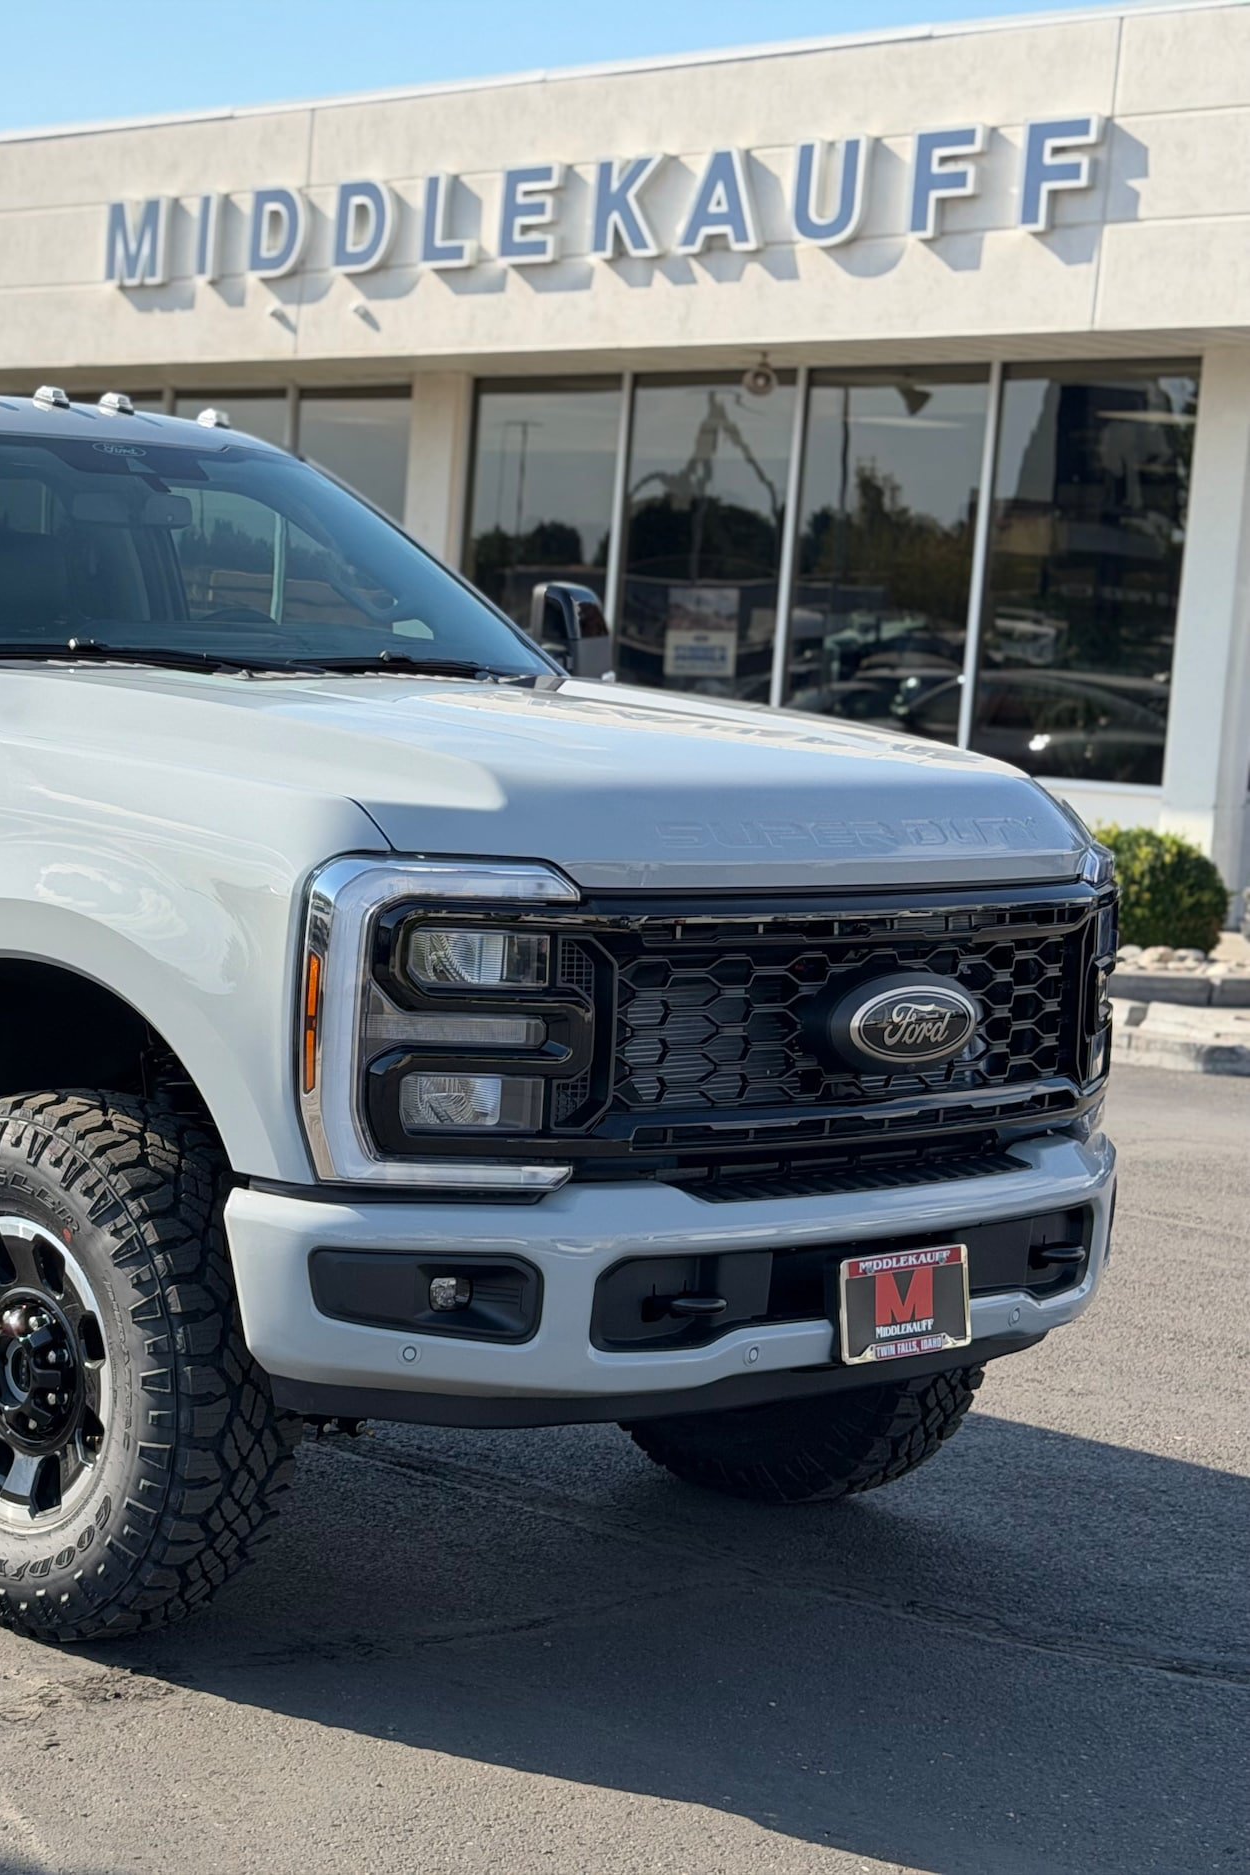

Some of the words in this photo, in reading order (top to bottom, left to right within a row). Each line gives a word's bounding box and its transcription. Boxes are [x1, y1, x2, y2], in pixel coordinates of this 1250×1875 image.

[104, 112, 1104, 288] MIDDLEKAUFF
[654, 820, 900, 850] SUPER
[901, 816, 1041, 846] DUTY
[883, 1002, 951, 1047] Ford
[875, 1266, 934, 1326] M
[875, 1318, 935, 1340] MIDDLEKAUFF
[876, 1342, 896, 1358] TWIN
[921, 1336, 943, 1350] IDAHO
